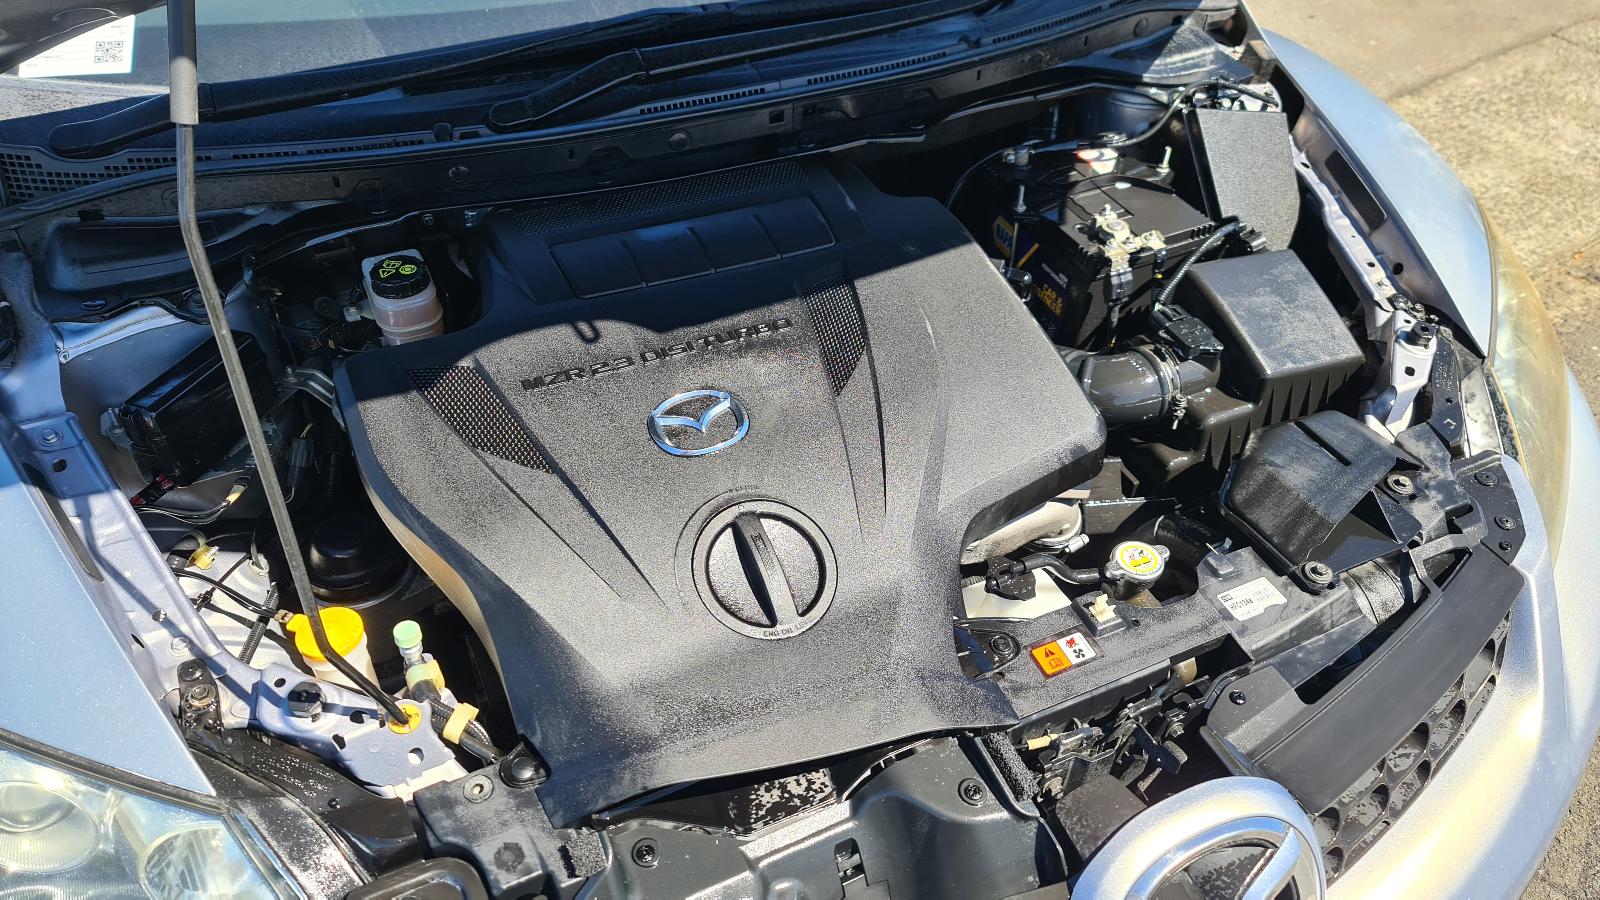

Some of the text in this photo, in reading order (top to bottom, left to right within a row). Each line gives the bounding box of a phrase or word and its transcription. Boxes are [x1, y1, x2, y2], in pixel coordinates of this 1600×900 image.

[521, 318, 793, 391] MZR 2.3 DISI TURBO
